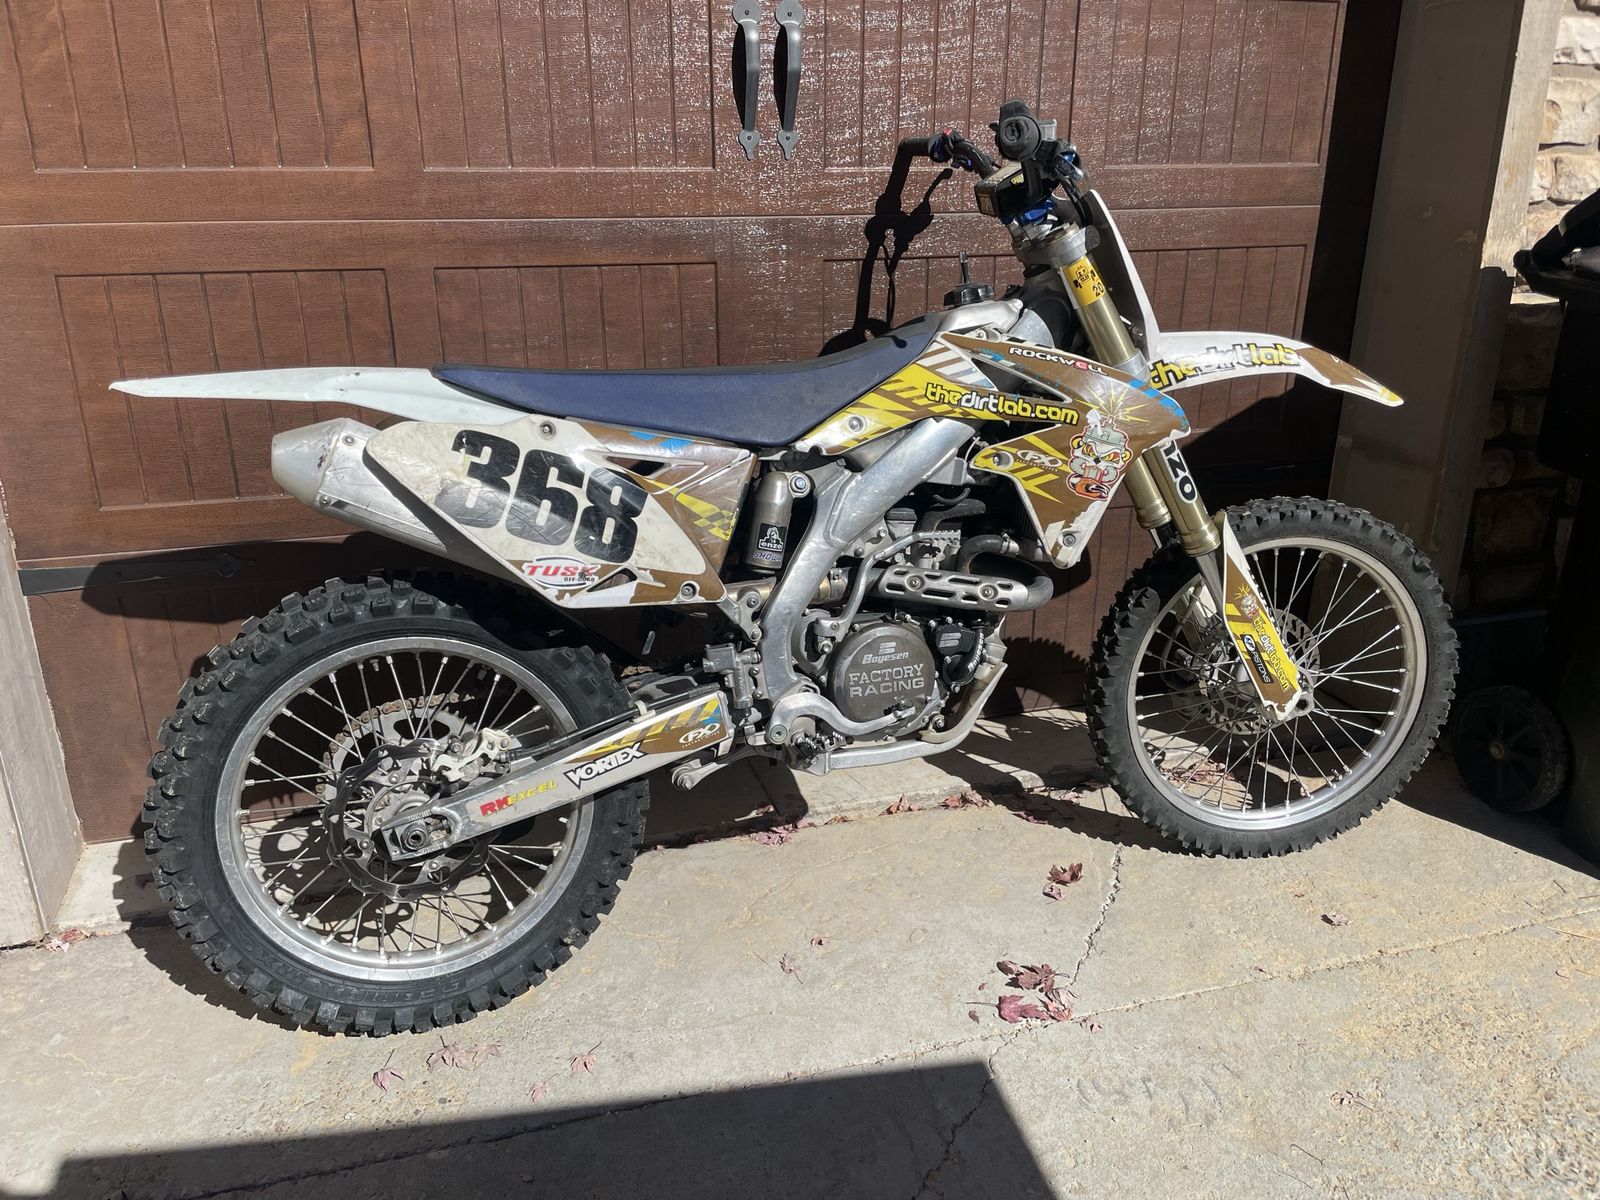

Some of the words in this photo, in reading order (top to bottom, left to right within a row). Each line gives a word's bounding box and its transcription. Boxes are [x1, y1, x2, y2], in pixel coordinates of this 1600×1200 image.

[1008, 347, 1109, 376] ROCKWELL
[925, 382, 1080, 426] thedirtlab.com
[434, 429, 649, 564] 368
[760, 541, 782, 549] enzo
[526, 564, 596, 577] TUSK
[862, 652, 909, 664] Boyesen
[1251, 650, 1271, 683] PISTONS
[848, 663, 924, 685] FACTORY
[849, 677, 925, 698] RACING
[564, 742, 647, 789] VORTEX
